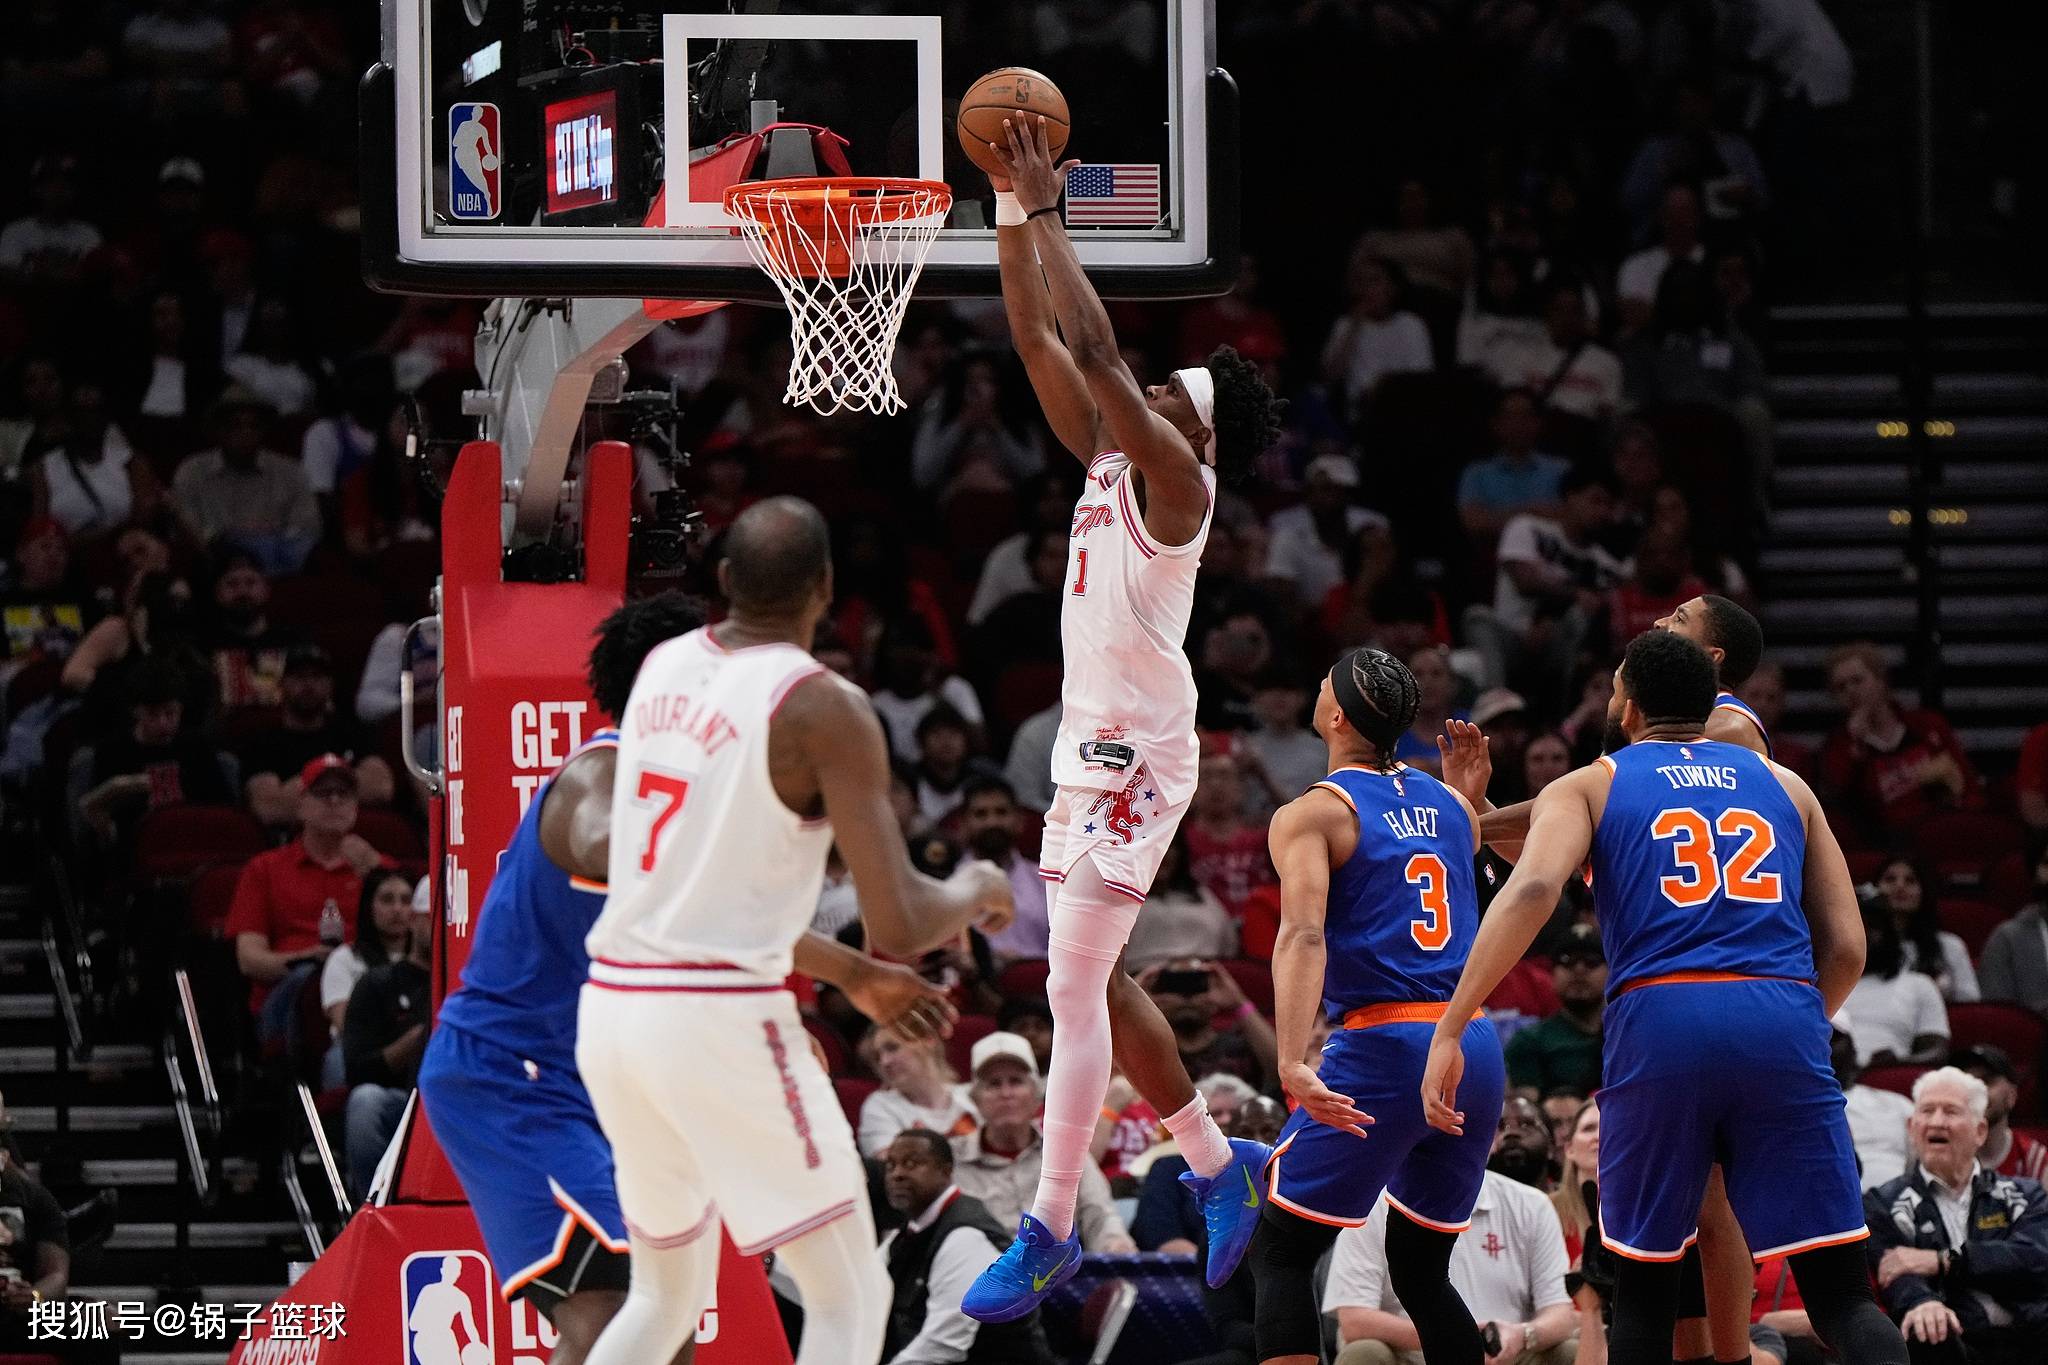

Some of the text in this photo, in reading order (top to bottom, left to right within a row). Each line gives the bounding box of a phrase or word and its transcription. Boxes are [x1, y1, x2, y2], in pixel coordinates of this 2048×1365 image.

[457, 193, 482, 212] NBA
[1072, 548, 1088, 596] 1
[511, 701, 588, 770] GET
[635, 694, 741, 757] DURANT
[1656, 765, 1737, 791] TOWNS
[635, 768, 692, 874] 7
[1383, 806, 1439, 840] HART
[1650, 807, 1783, 908] 32
[1404, 853, 1452, 951] 3
